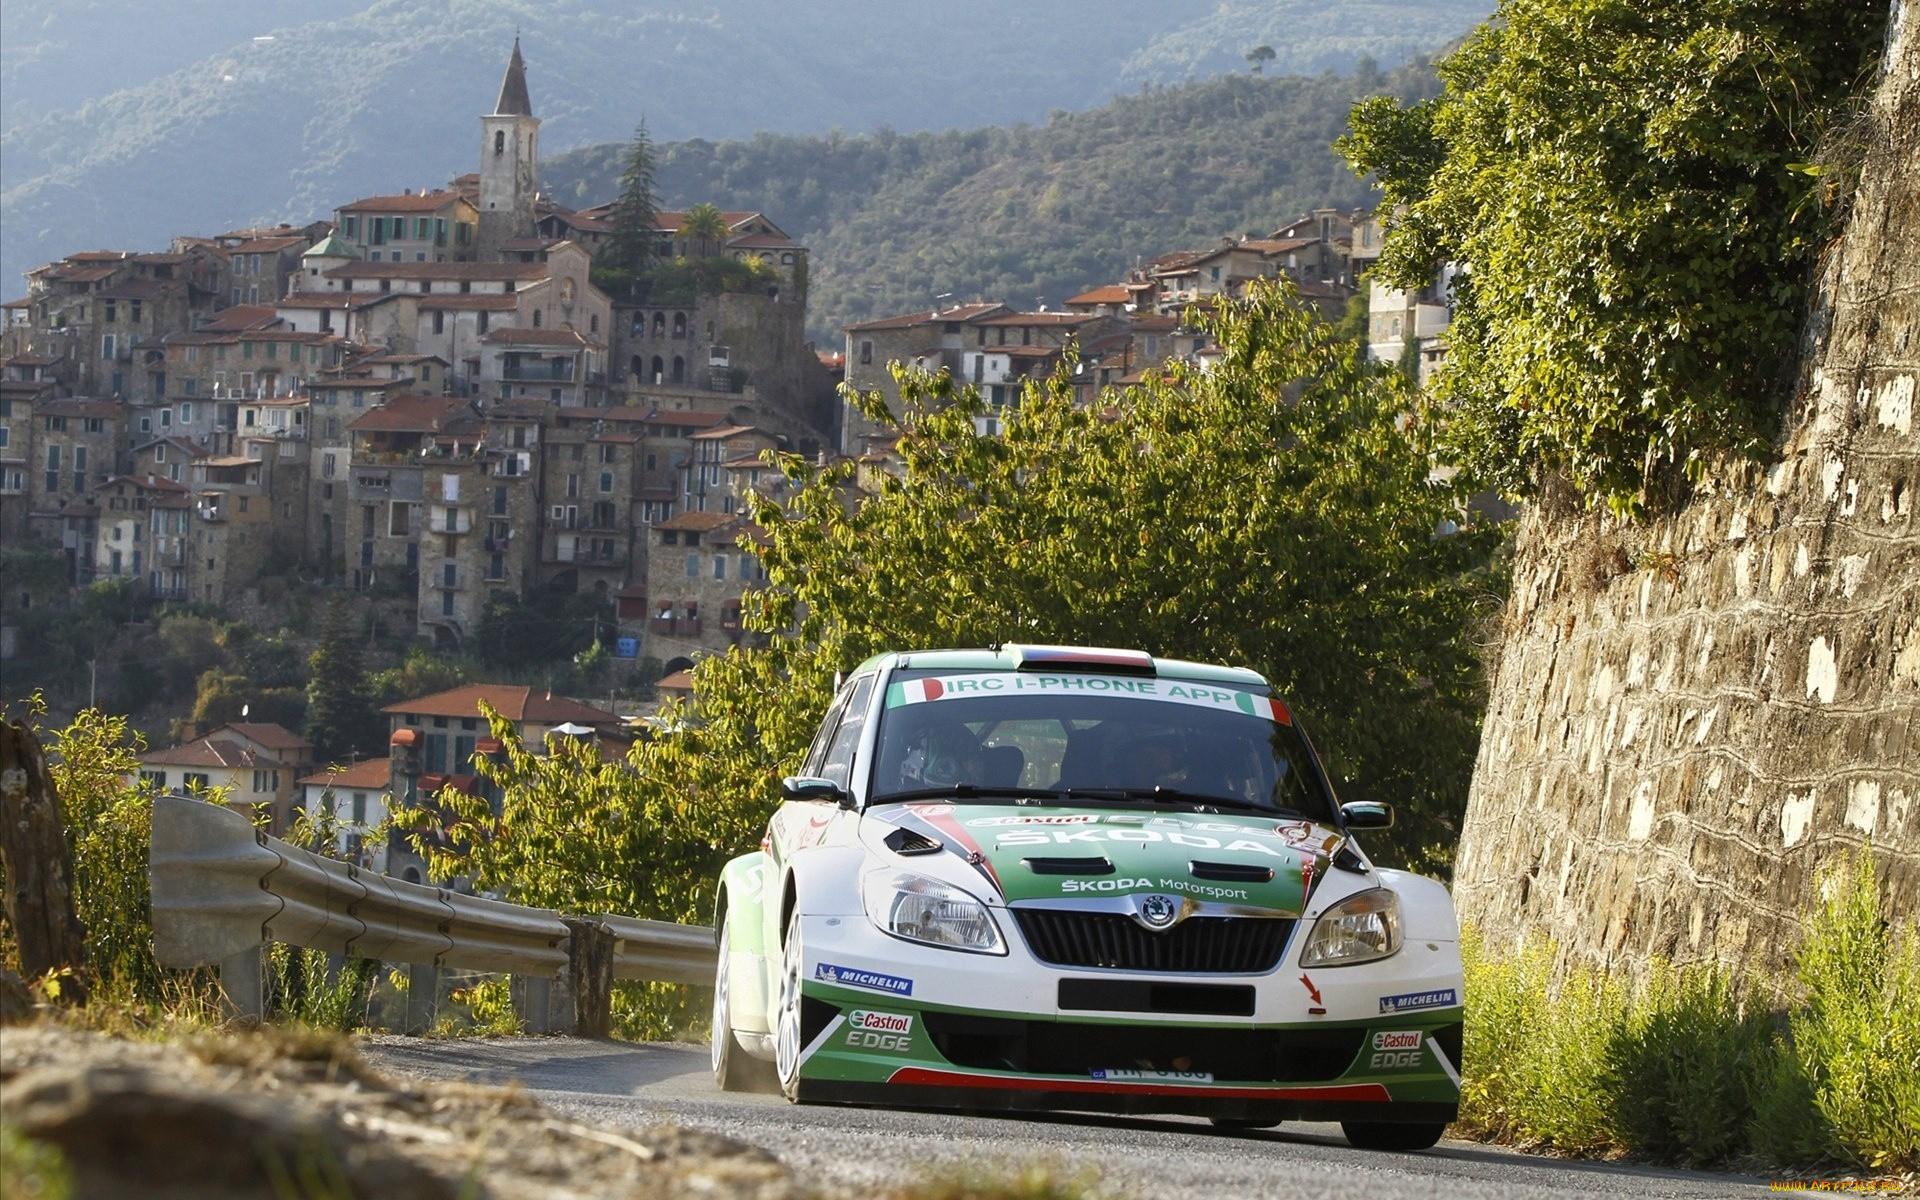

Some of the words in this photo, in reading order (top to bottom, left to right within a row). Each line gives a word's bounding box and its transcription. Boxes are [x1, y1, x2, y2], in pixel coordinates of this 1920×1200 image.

[946, 677, 1004, 693] IRC
[1015, 677, 1158, 695] I-PHONE
[1168, 685, 1232, 703] APP
[999, 815, 1091, 826] Castrol
[996, 829, 1282, 857] ŠKODA
[1061, 877, 1154, 893] ŠKODA
[1159, 878, 1248, 900] Motorsport
[840, 970, 909, 991] MICHELIN
[1397, 992, 1452, 1007] MICHELIN
[864, 1013, 909, 1032] Castrol
[845, 1031, 913, 1052] EDGE
[1383, 1032, 1419, 1048] Castrol
[1369, 1052, 1423, 1069] EDGE
